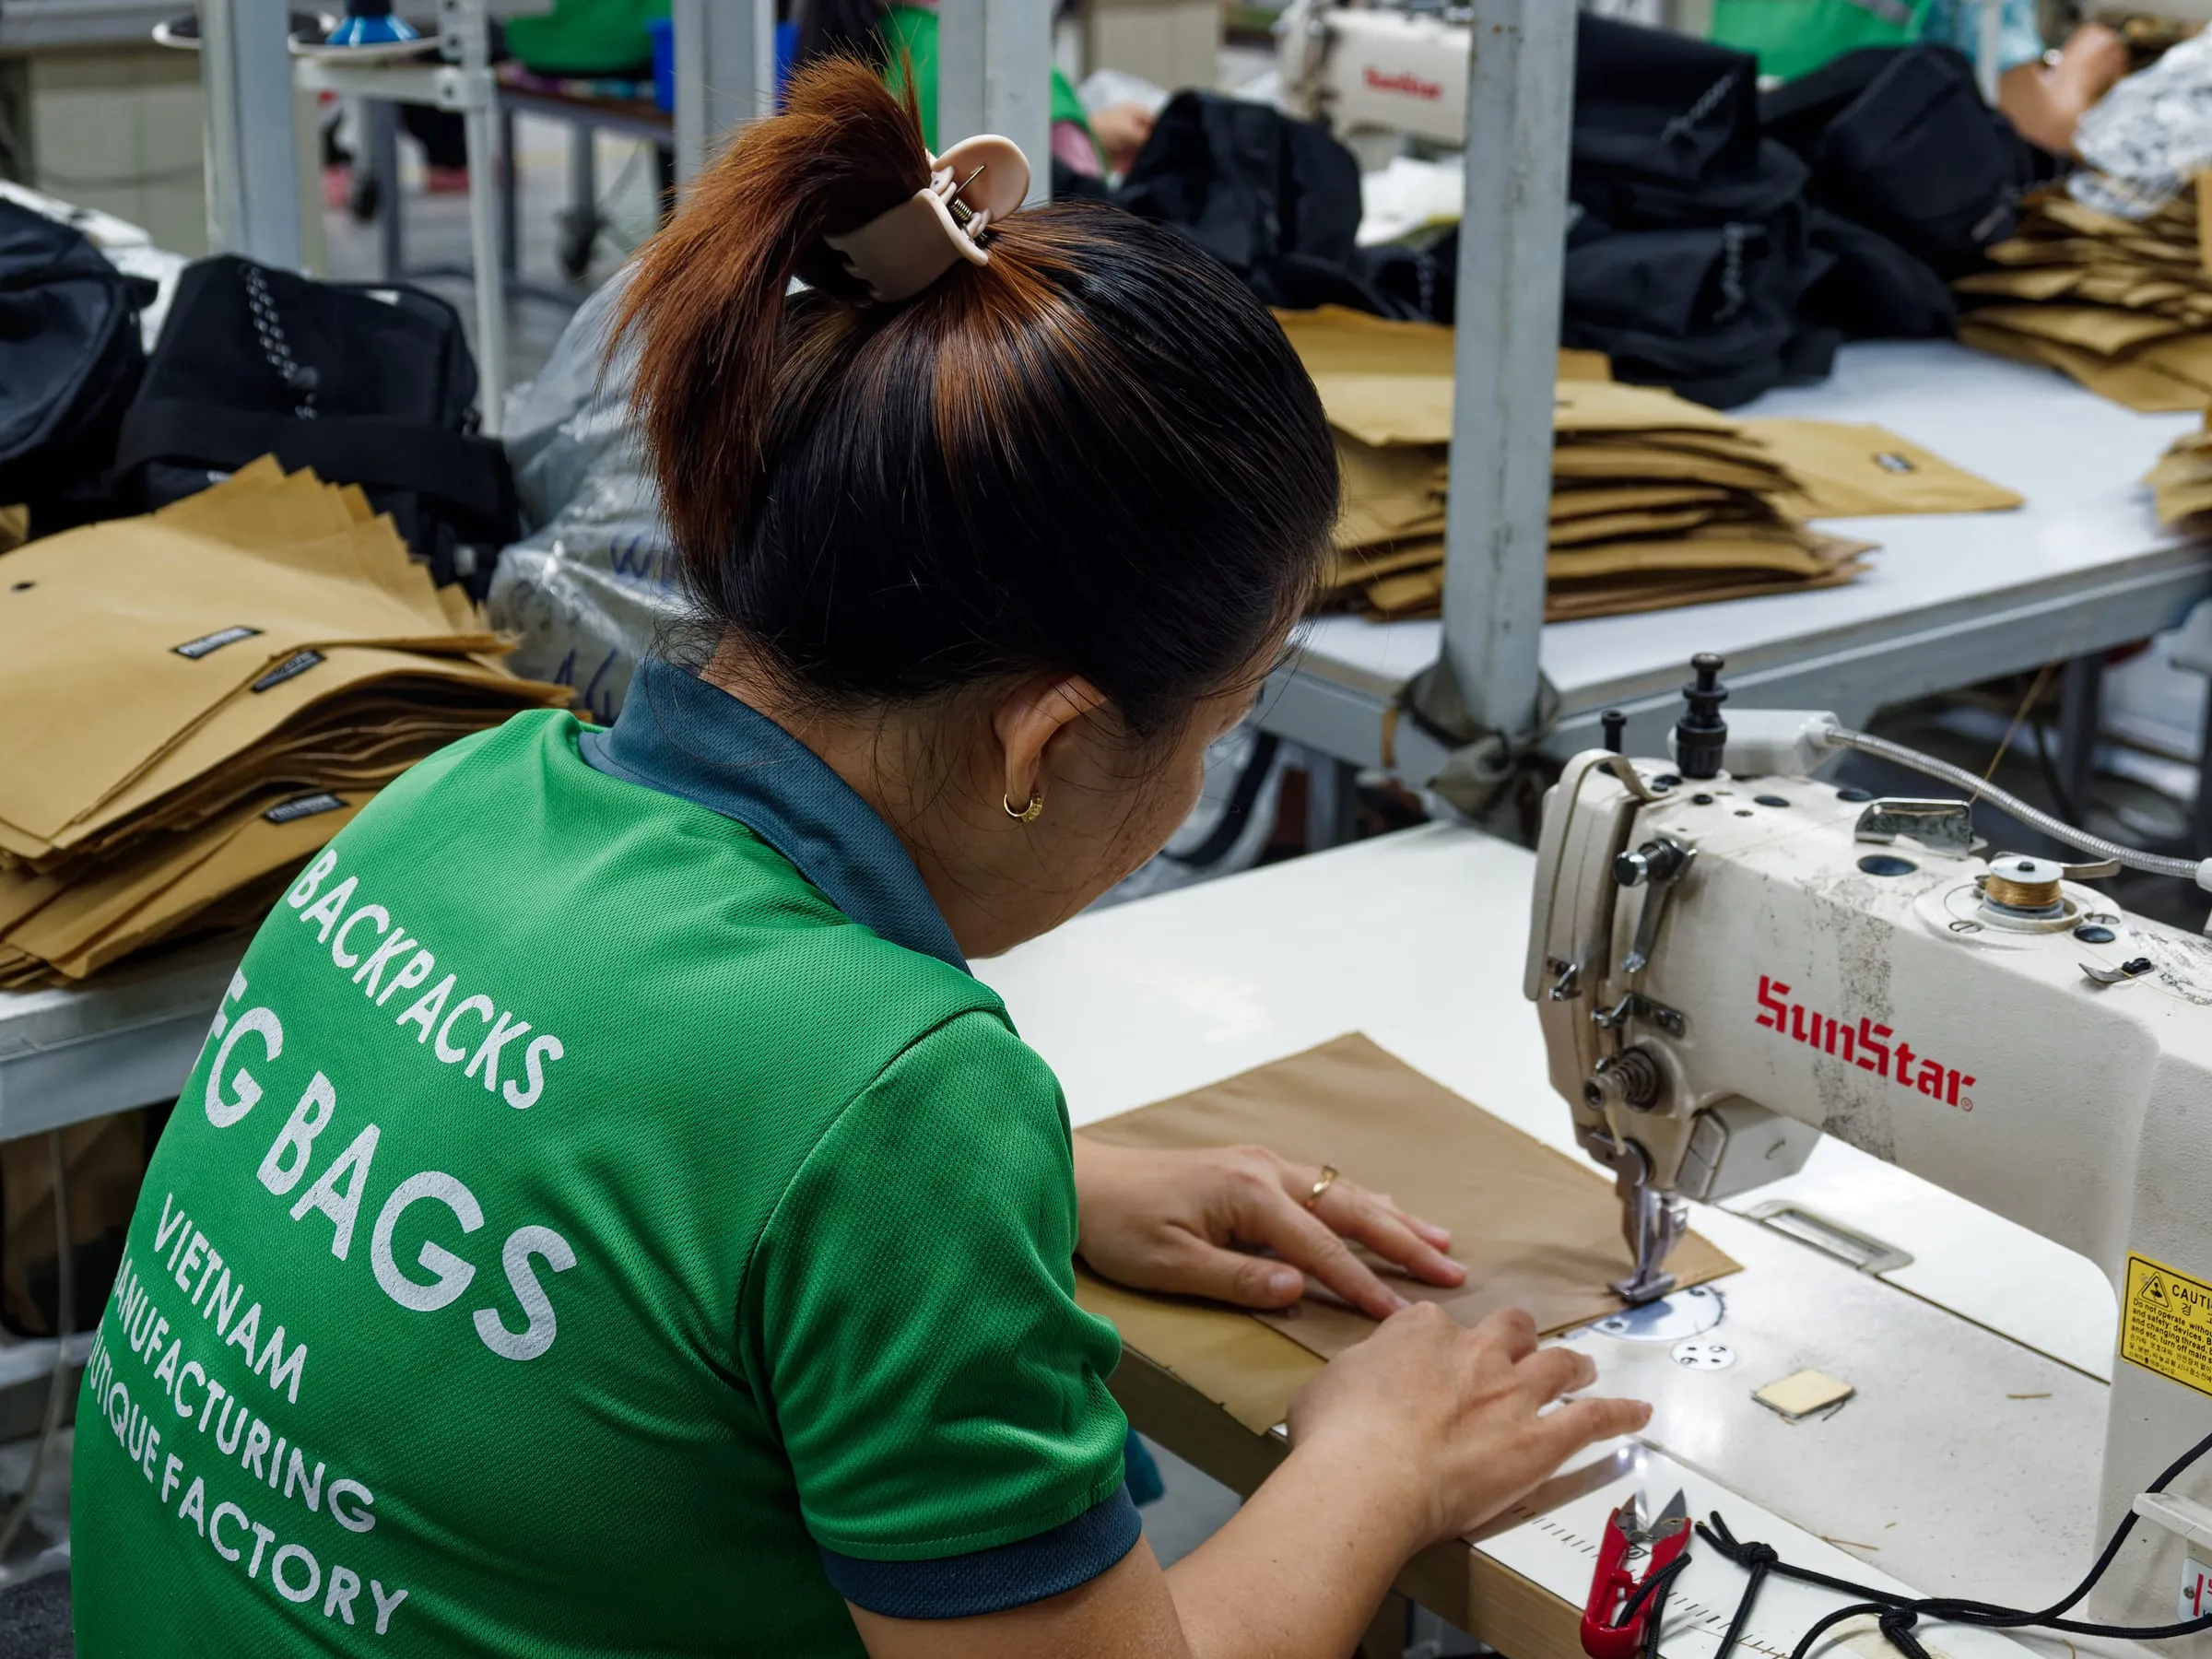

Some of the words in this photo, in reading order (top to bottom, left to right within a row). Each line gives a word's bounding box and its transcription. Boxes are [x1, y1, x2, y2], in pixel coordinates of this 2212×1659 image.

[287, 848, 564, 1110] BACKPACKS
[257, 1071, 578, 1361] BAGS
[154, 1193, 308, 1405] VIETNAM
[2132, 1308, 2146, 1318] and
[2133, 1297, 2144, 1309] Do
[2145, 1304, 2157, 1314] not
[2158, 1310, 2185, 1325] operate
[2171, 1284, 2212, 1310] CAUTI
[2131, 1316, 2145, 1326] and
[2147, 1323, 2180, 1343] changing
[2131, 1324, 2144, 1335] and
[2160, 1336, 2175, 1348] turn
[2176, 1345, 2187, 1353] off
[2189, 1348, 2206, 1361] main
[162, 1453, 408, 1635] FACTORY
